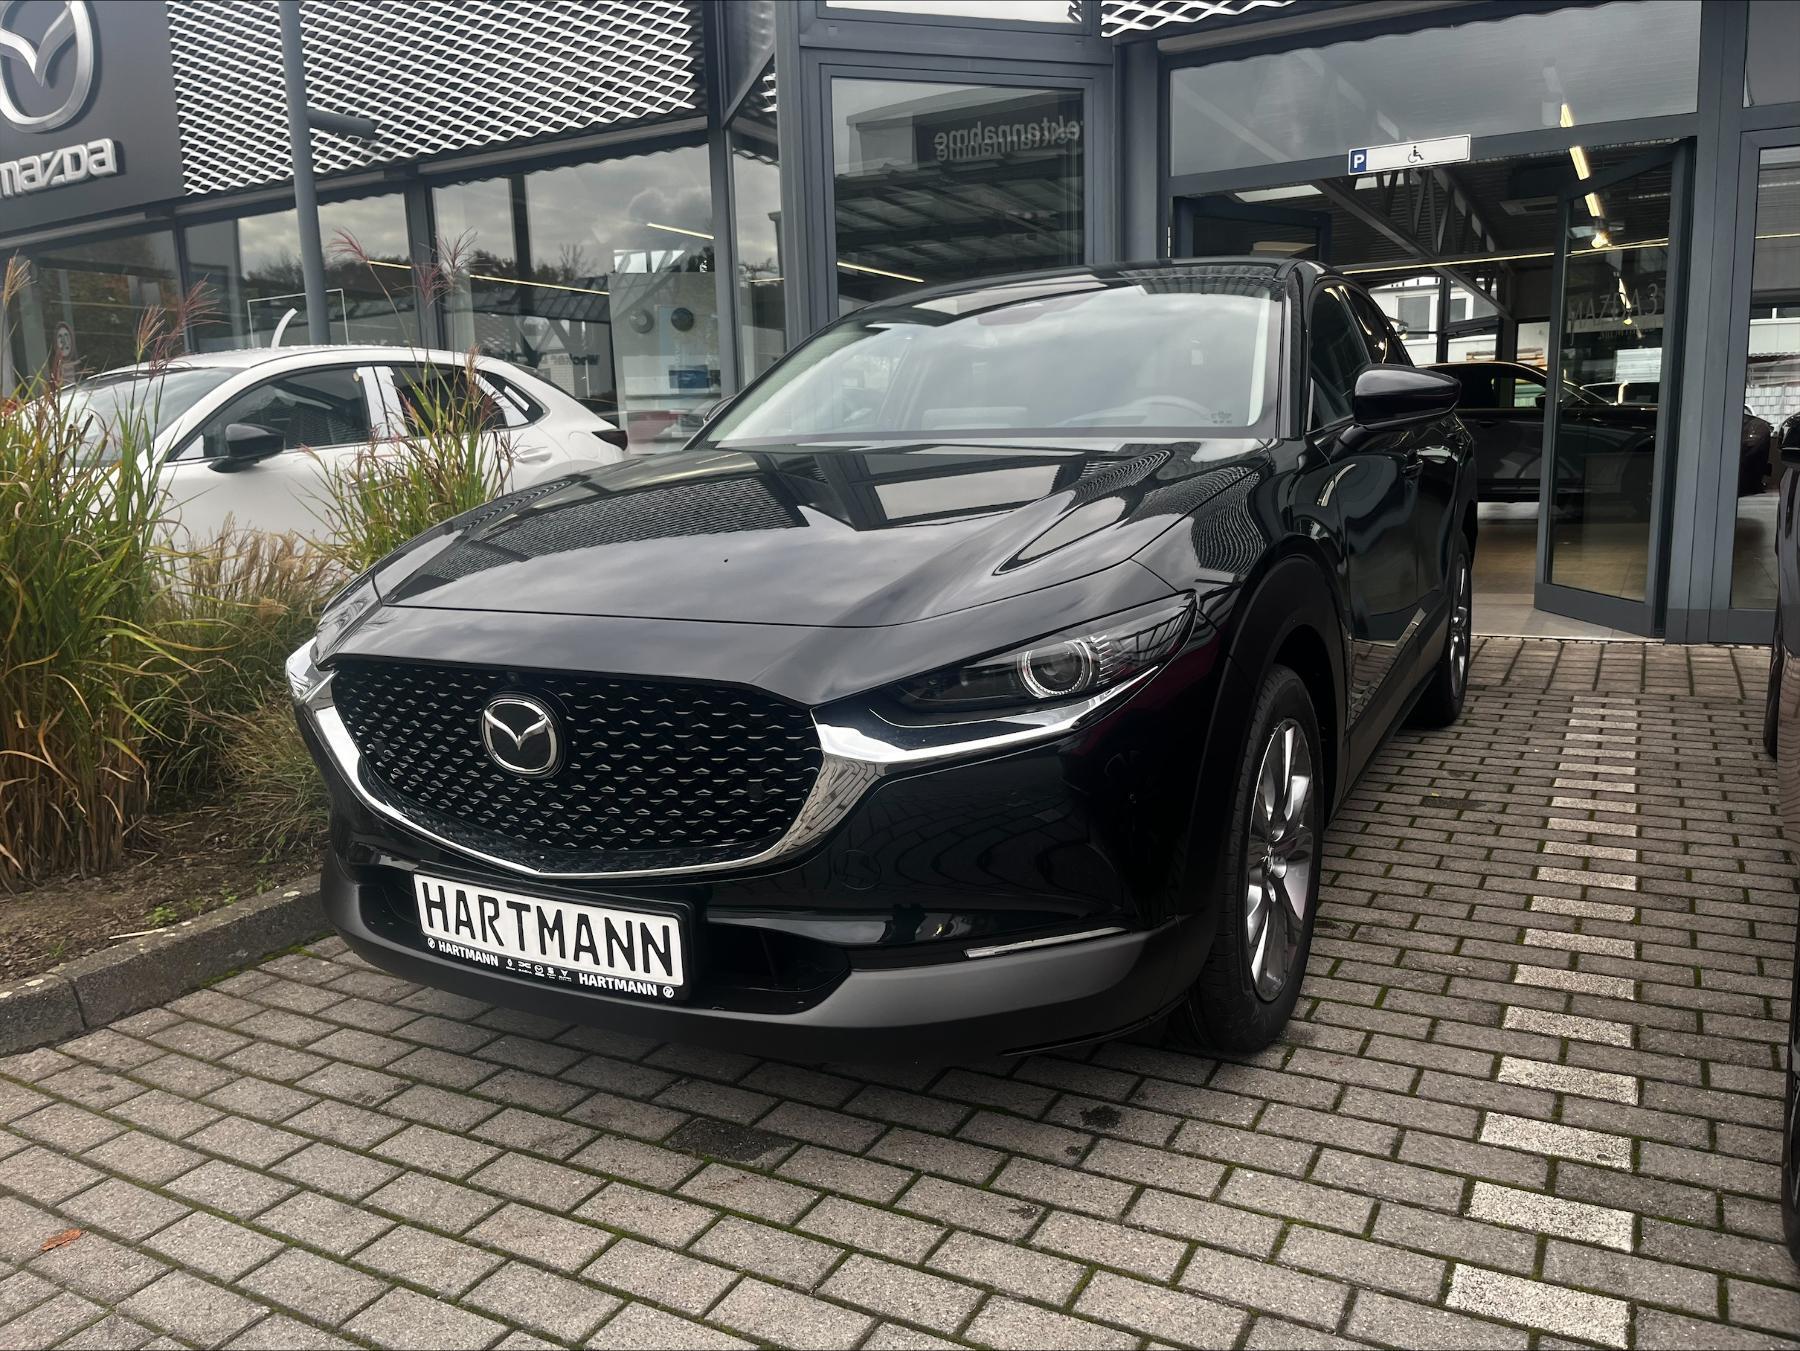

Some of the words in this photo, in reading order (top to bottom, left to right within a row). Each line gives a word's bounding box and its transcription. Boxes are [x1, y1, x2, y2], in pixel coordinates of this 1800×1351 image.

[1354, 154, 1365, 169] P
[422, 882, 673, 976] HARTMANN
[438, 941, 499, 967] HARTMANN
[579, 973, 658, 997] HARTMANN
